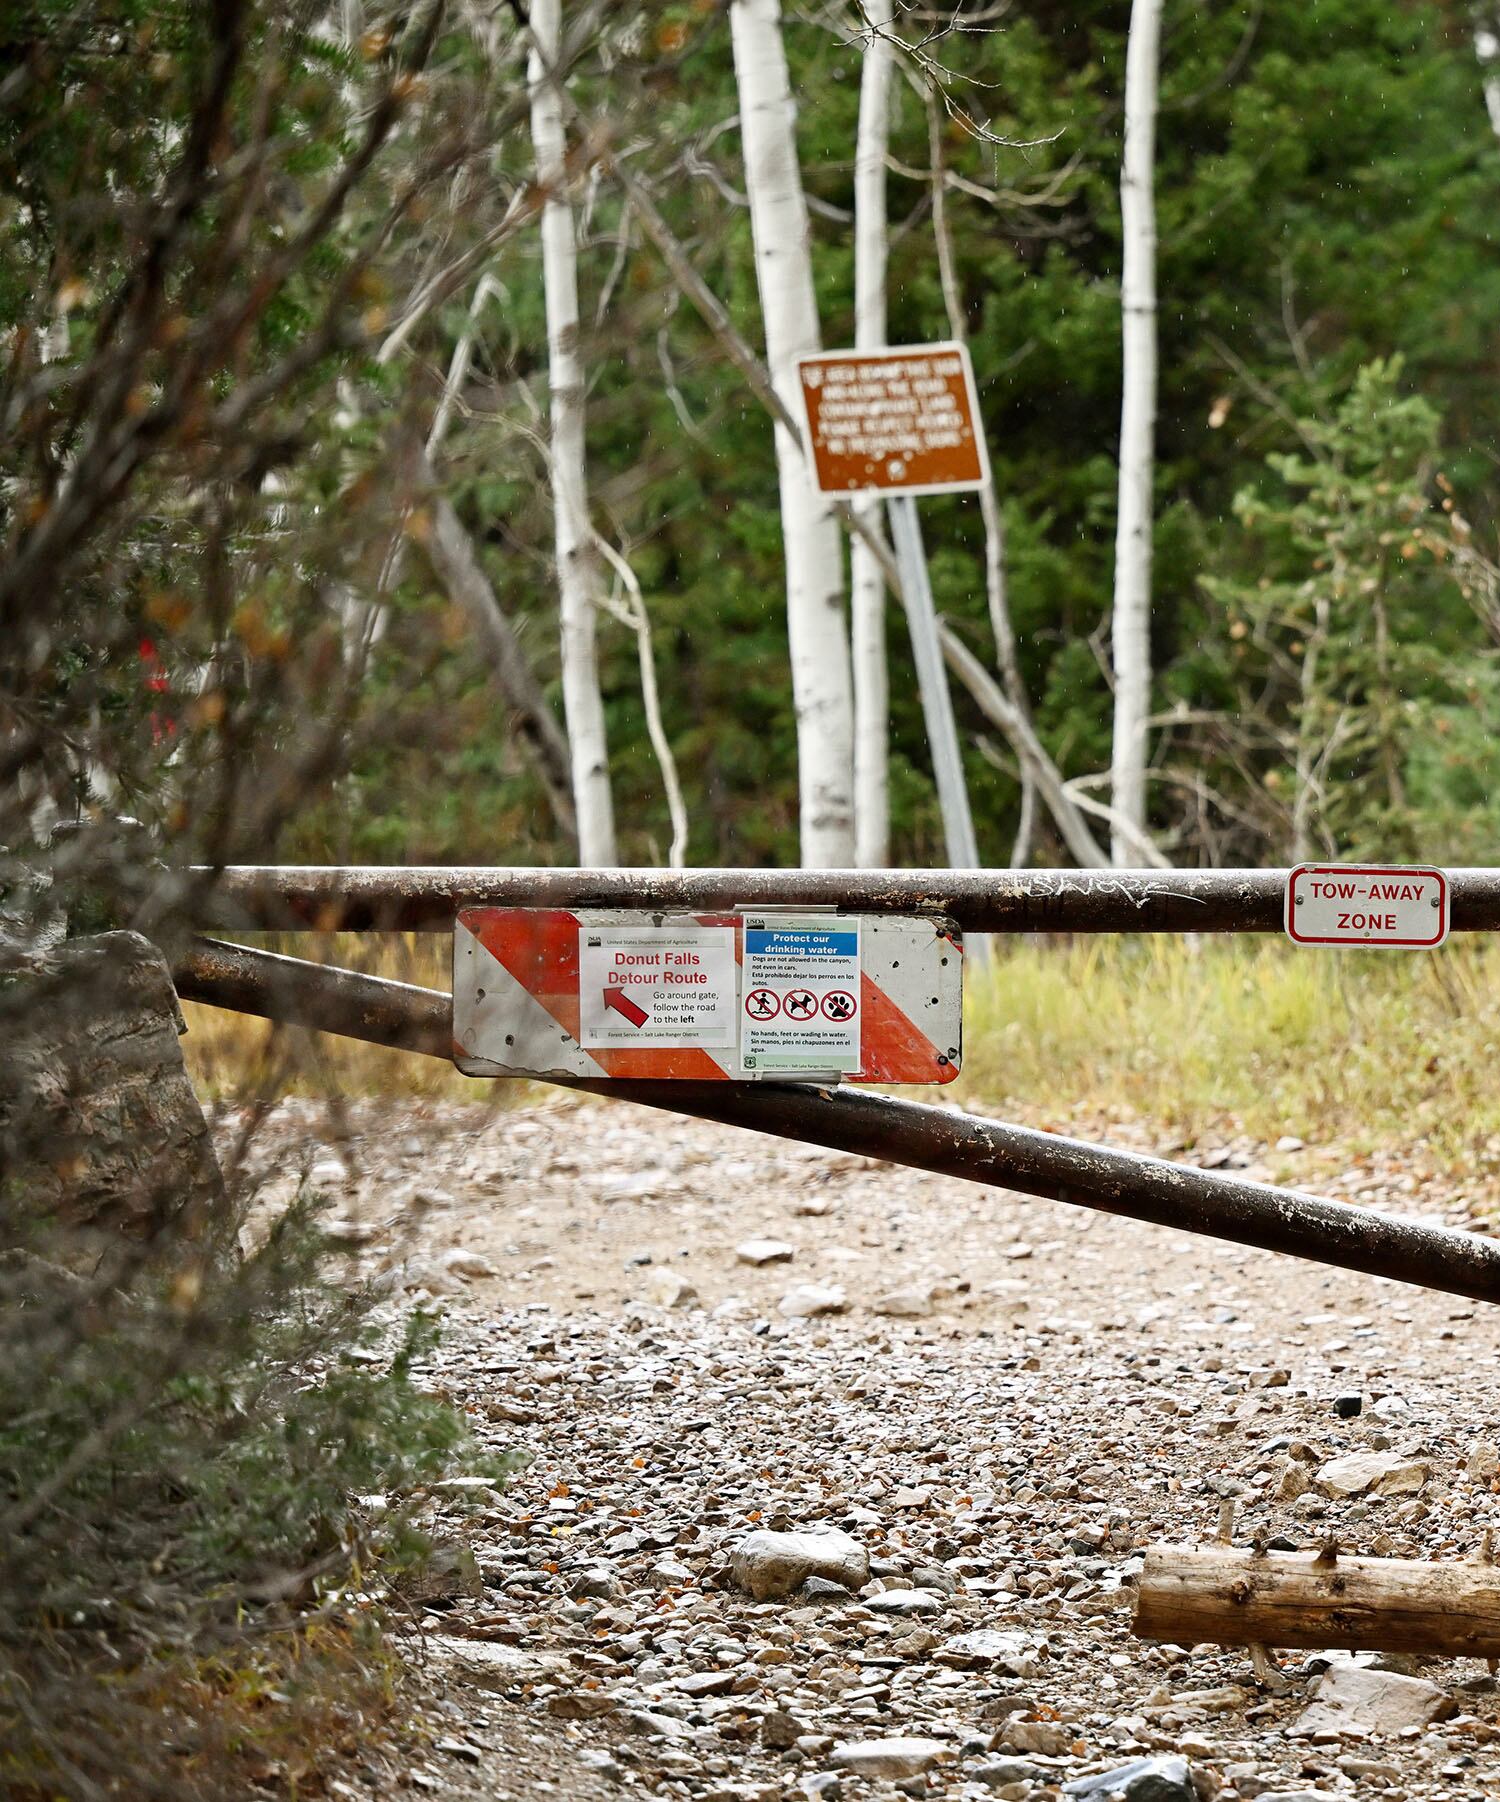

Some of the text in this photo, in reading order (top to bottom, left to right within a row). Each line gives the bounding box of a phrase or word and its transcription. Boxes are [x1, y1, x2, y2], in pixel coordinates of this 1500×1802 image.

[1310, 882, 1425, 900] TOW-AWAY
[1337, 913, 1397, 930] ZONE
[638, 939, 667, 947] Department
[673, 939, 698, 947] Agriculture
[773, 934, 810, 943] Protect
[765, 944, 838, 955] drinking water
[615, 952, 700, 965] Donut Falls
[752, 955, 766, 963] Dogs
[608, 972, 707, 984] Detour Route
[653, 991, 719, 1003] Go around gate,
[653, 1003, 716, 1012] follow the road
[653, 1015, 695, 1024] to the left
[801, 1039, 835, 1047] chapuzones
